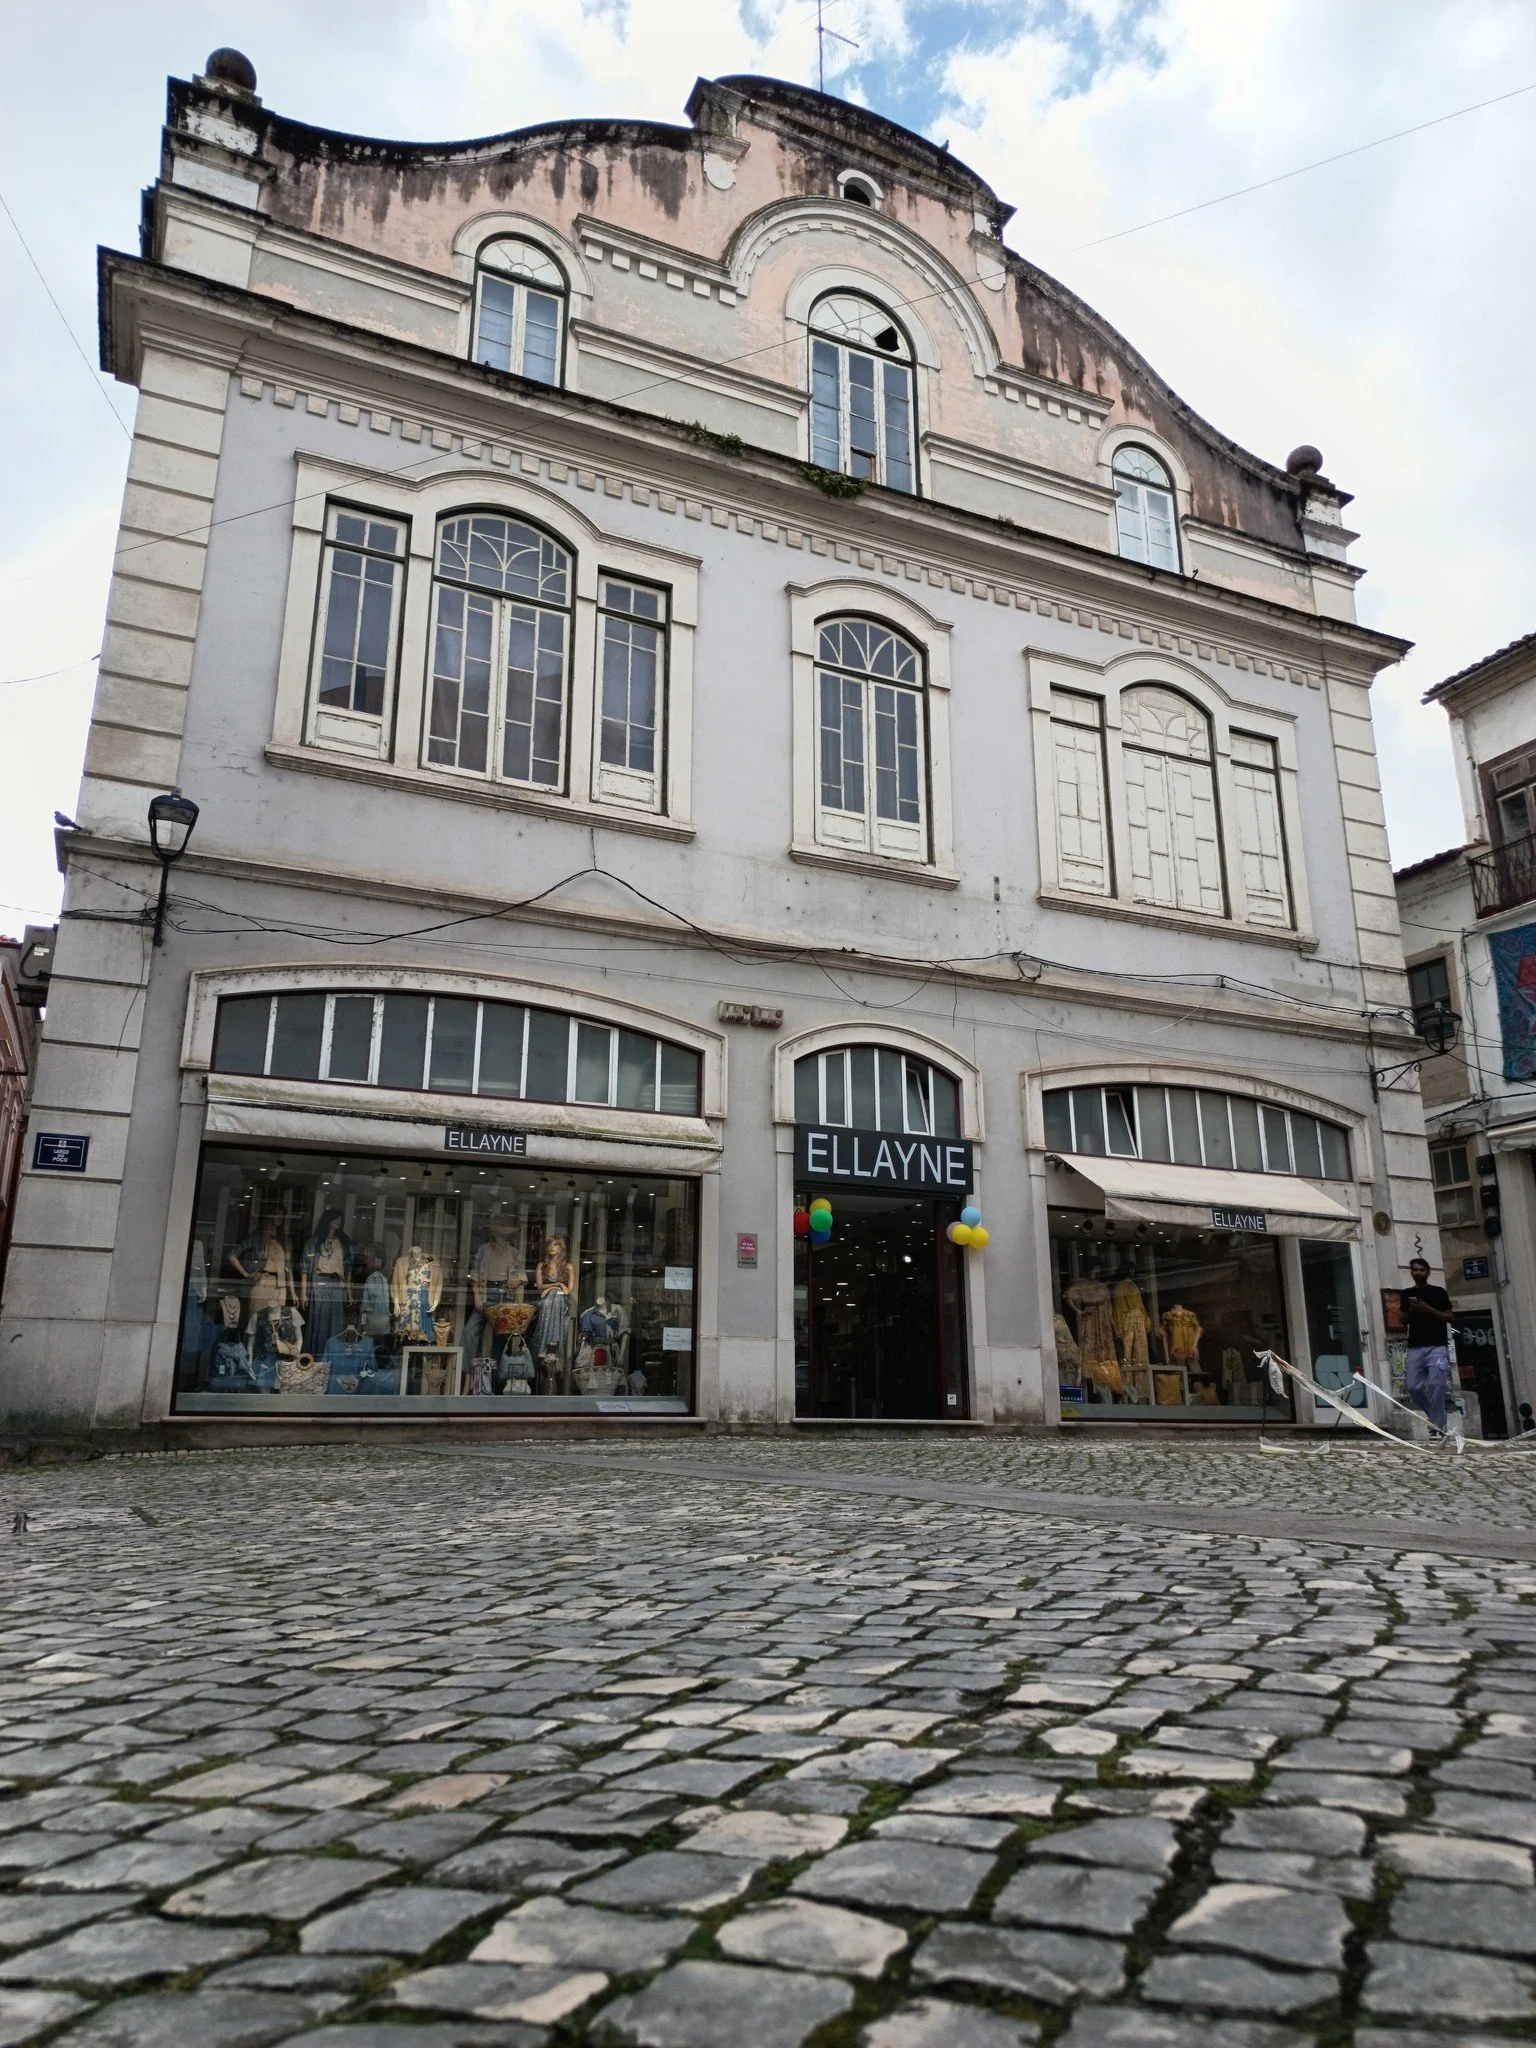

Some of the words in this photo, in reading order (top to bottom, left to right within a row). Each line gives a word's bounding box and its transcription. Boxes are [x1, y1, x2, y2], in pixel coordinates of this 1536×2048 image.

[448, 1131, 524, 1153] ELLAYNE
[807, 1132, 966, 1186] ELLAYNE
[1213, 1212, 1265, 1230] ELLAYNE
